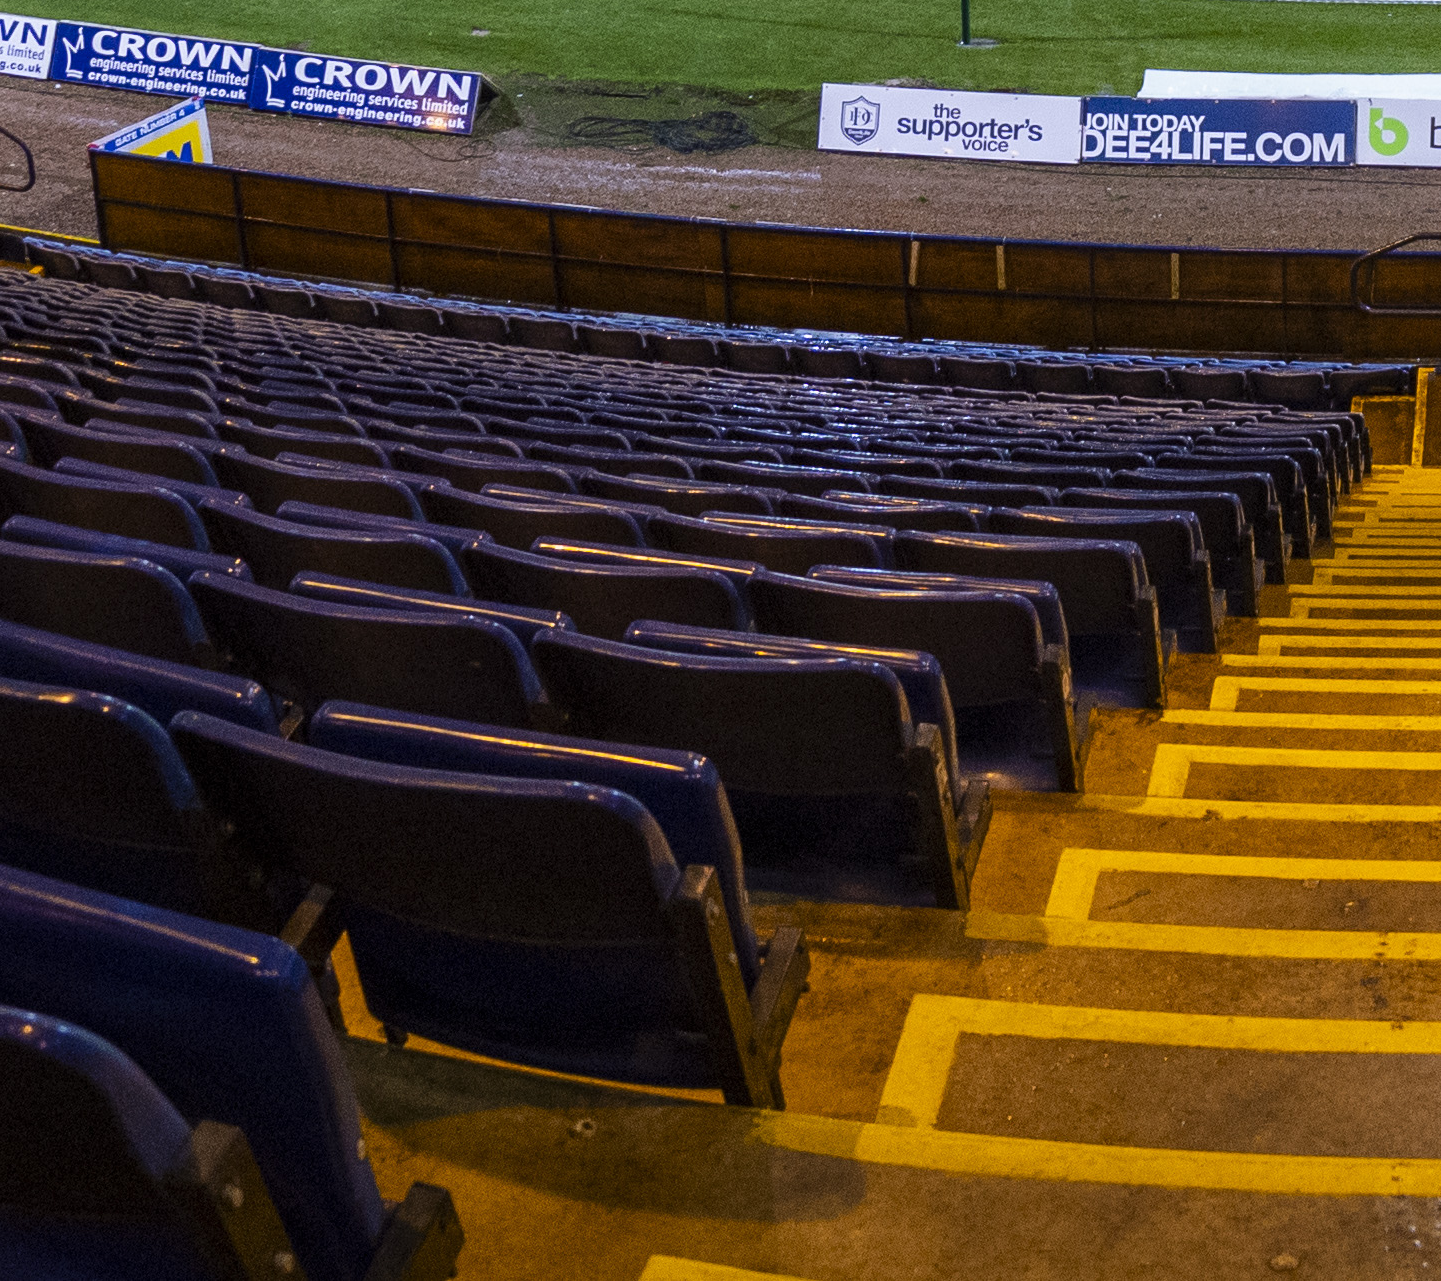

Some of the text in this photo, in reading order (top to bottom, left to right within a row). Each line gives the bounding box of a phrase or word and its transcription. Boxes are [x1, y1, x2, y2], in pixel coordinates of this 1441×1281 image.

[7, 44, 45, 62] limited
[91, 29, 253, 73] CROWN
[87, 70, 246, 101] crown-engineering.co.uk
[90, 55, 249, 88] engineering services limited
[293, 57, 472, 100] CROWN
[290, 97, 466, 131] crown-engineering.co.uk
[292, 83, 469, 117] engineering services limited
[933, 103, 961, 119] the
[115, 109, 186, 147] GATE NUMBER 4
[896, 117, 1043, 142] supporter's
[1083, 112, 1206, 133] JOIN TODAY
[962, 137, 1009, 153] voice
[1082, 129, 1346, 164] DEE4LIFE.COM
